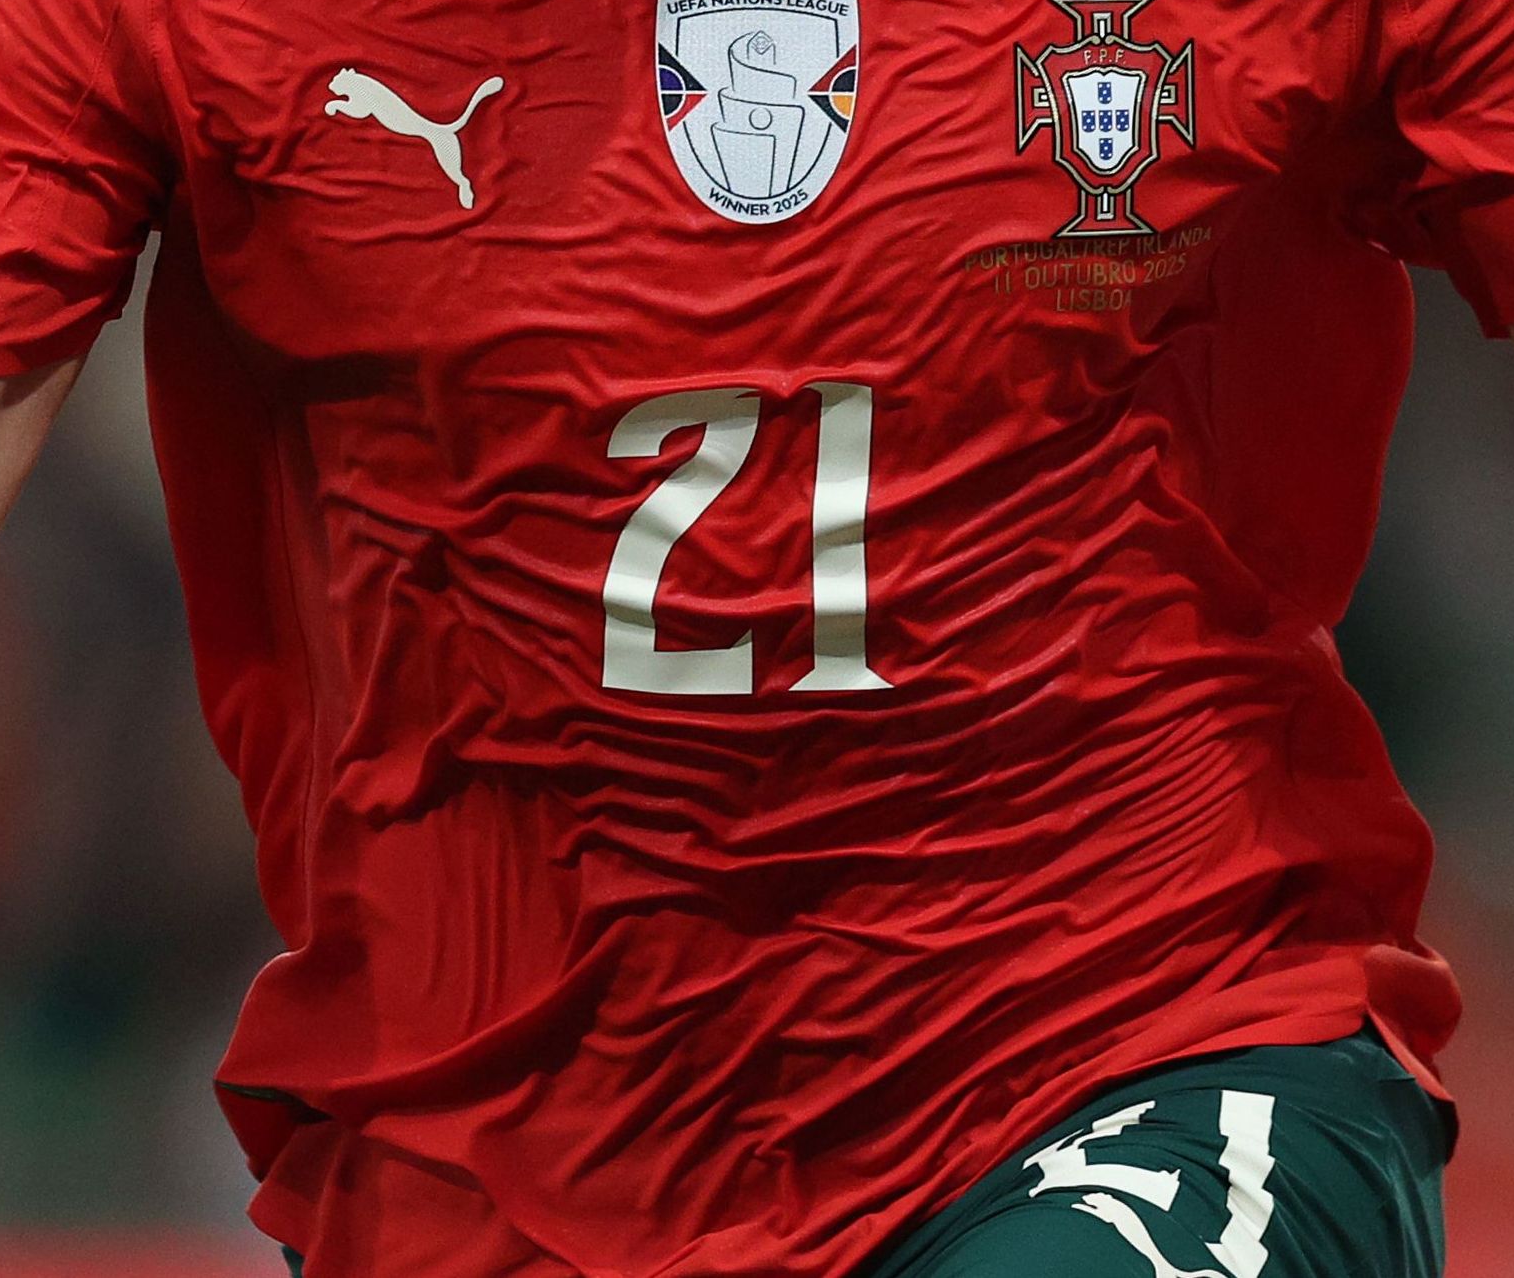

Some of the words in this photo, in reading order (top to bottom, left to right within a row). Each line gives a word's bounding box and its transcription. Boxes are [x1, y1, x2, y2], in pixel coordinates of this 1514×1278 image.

[709, 187, 770, 216] WINNER
[774, 188, 809, 214] 2025
[1024, 260, 1136, 290] OUTUBRO
[1143, 253, 1188, 284] 2025
[602, 381, 895, 695] 21
